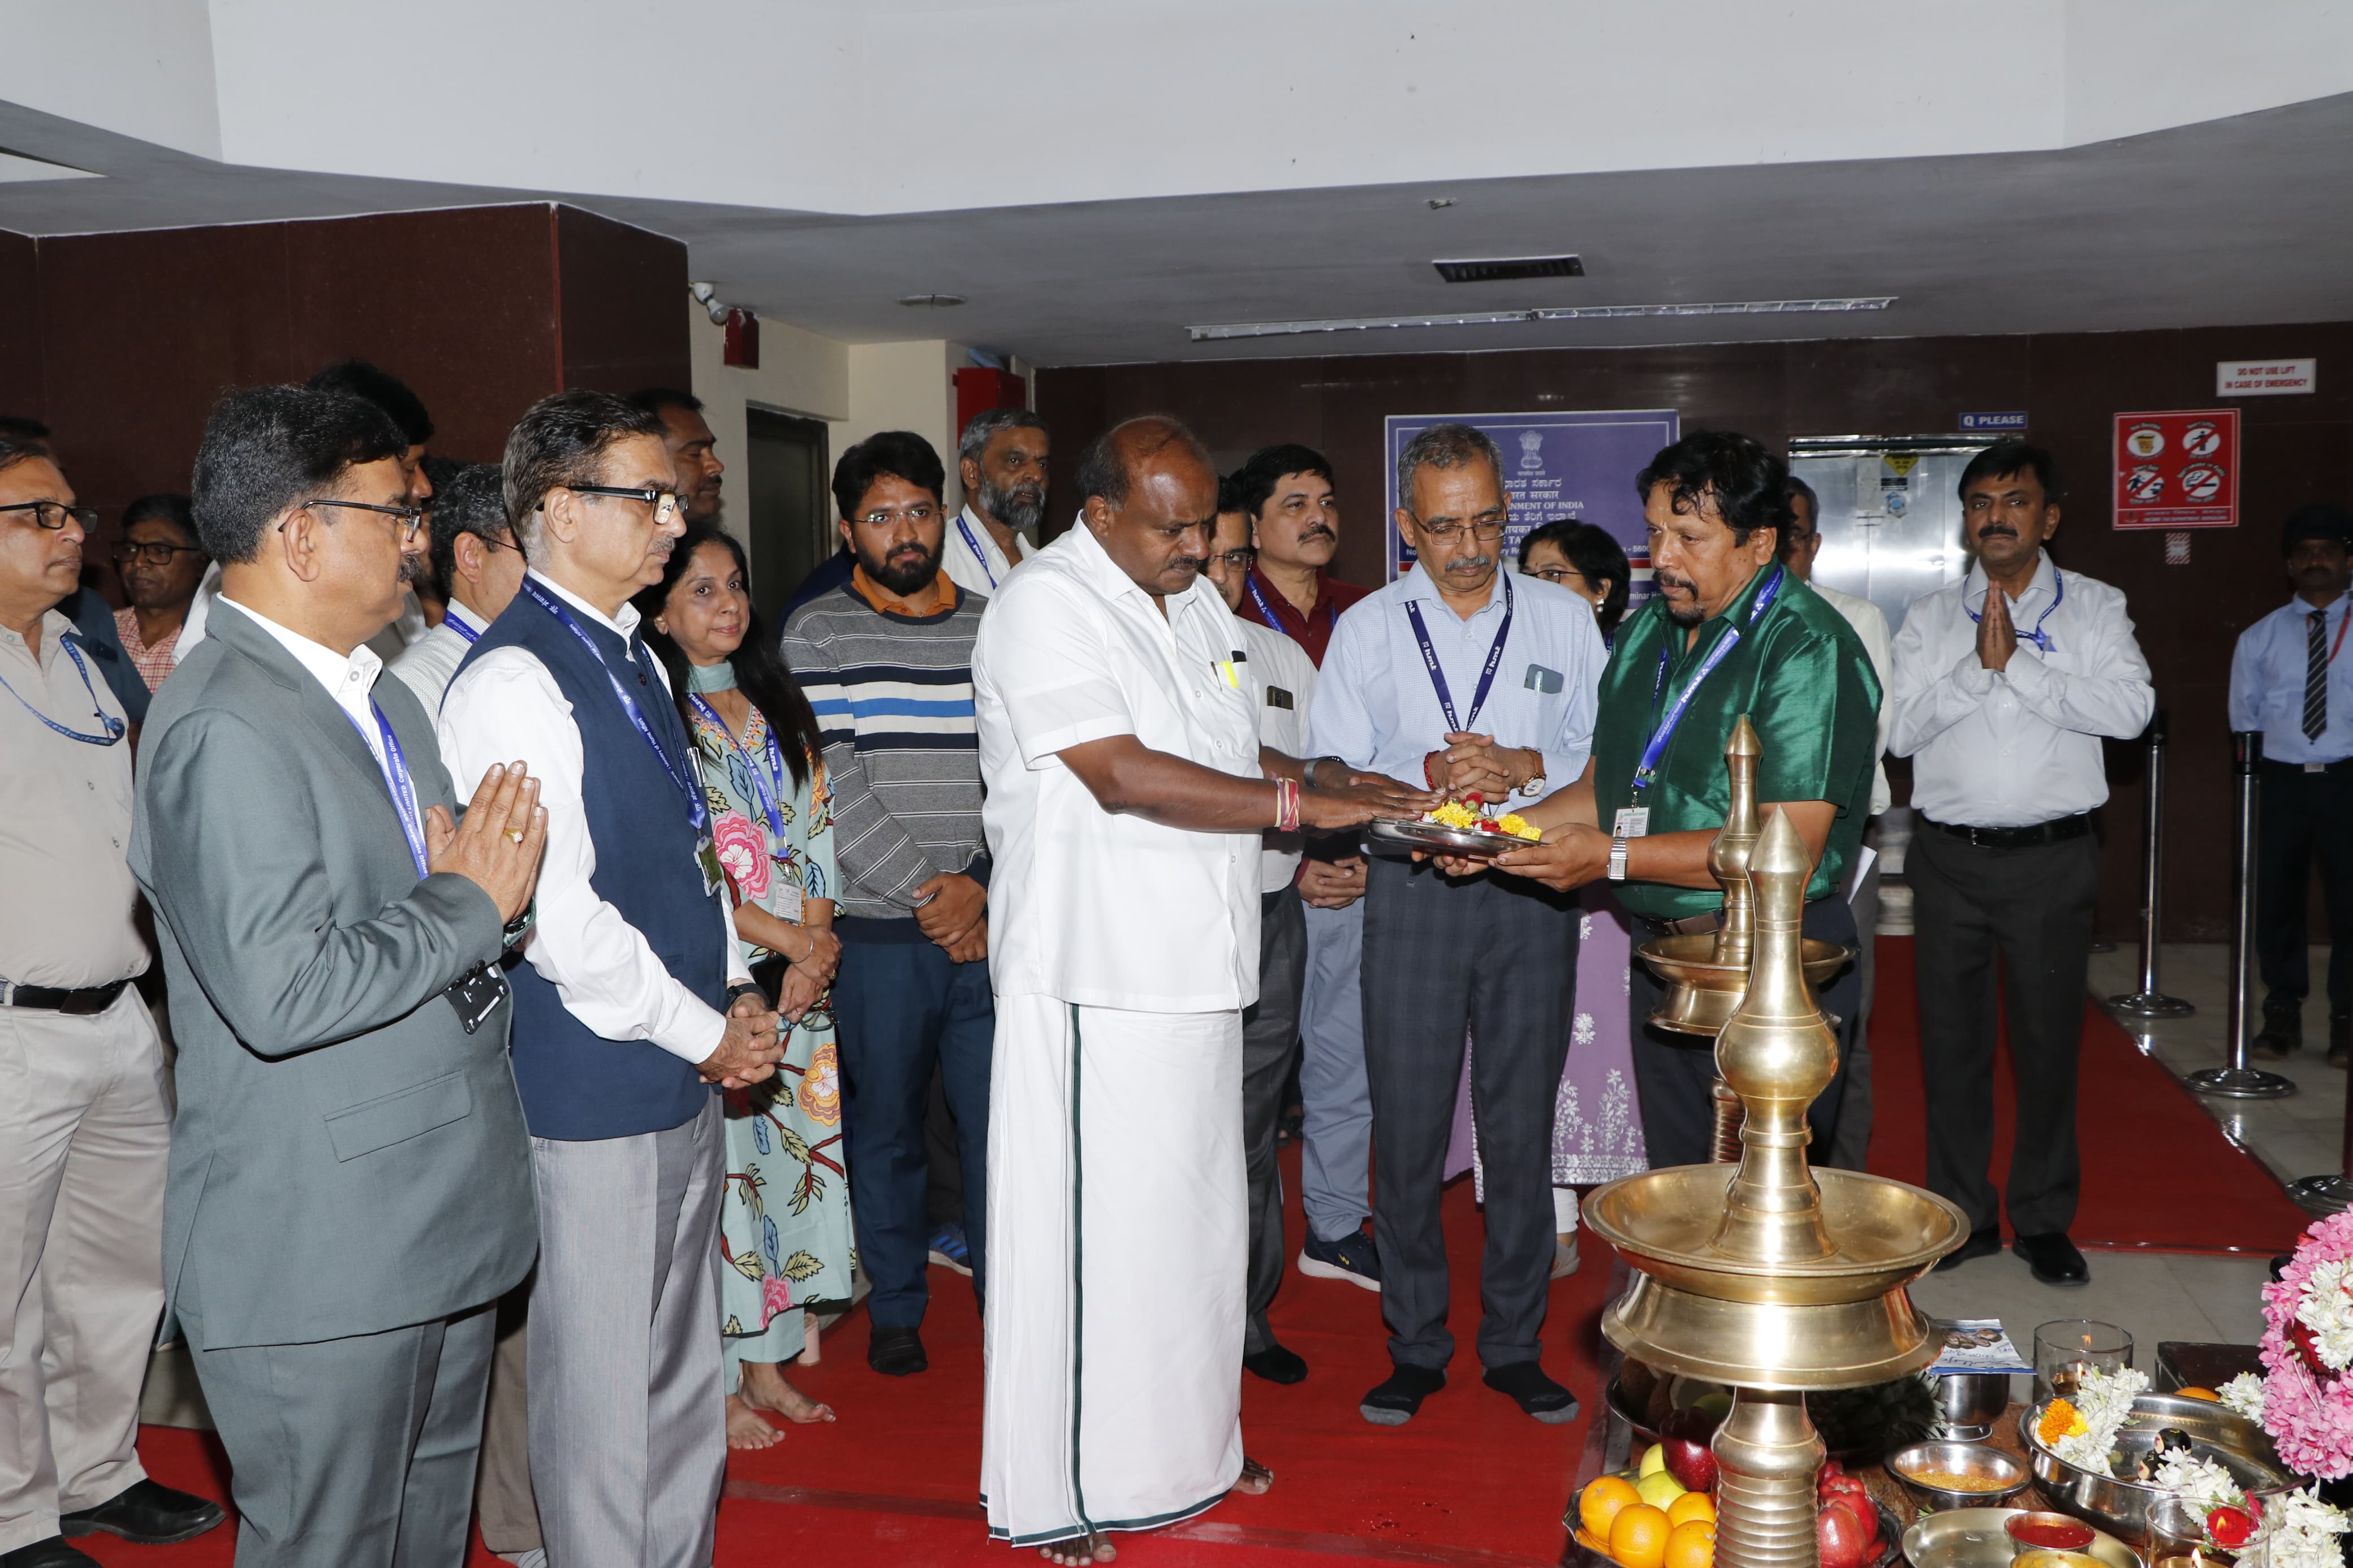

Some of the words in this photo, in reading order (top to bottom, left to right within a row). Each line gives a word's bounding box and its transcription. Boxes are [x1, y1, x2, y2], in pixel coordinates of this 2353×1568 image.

[2281, 366, 2295, 374] LIFT
[2265, 379, 2307, 387] EMERGENCY
[1963, 416, 1975, 426] Q
[1979, 416, 2024, 425] PLEASE
[1529, 491, 1559, 499] सरकार
[1252, 589, 1264, 608] hmt
[1425, 649, 1437, 671] hmt
[1489, 645, 1501, 668] hmt
[1681, 675, 1703, 703] hmt
[638, 717, 648, 732] Affairs
[387, 735, 397, 752] Office
[647, 731, 657, 746] Home
[393, 753, 404, 783] Corporate
[769, 747, 778, 771] hmt
[401, 785, 412, 810] LIMITED
[408, 824, 421, 854] Corporate
[419, 855, 428, 874] Office
